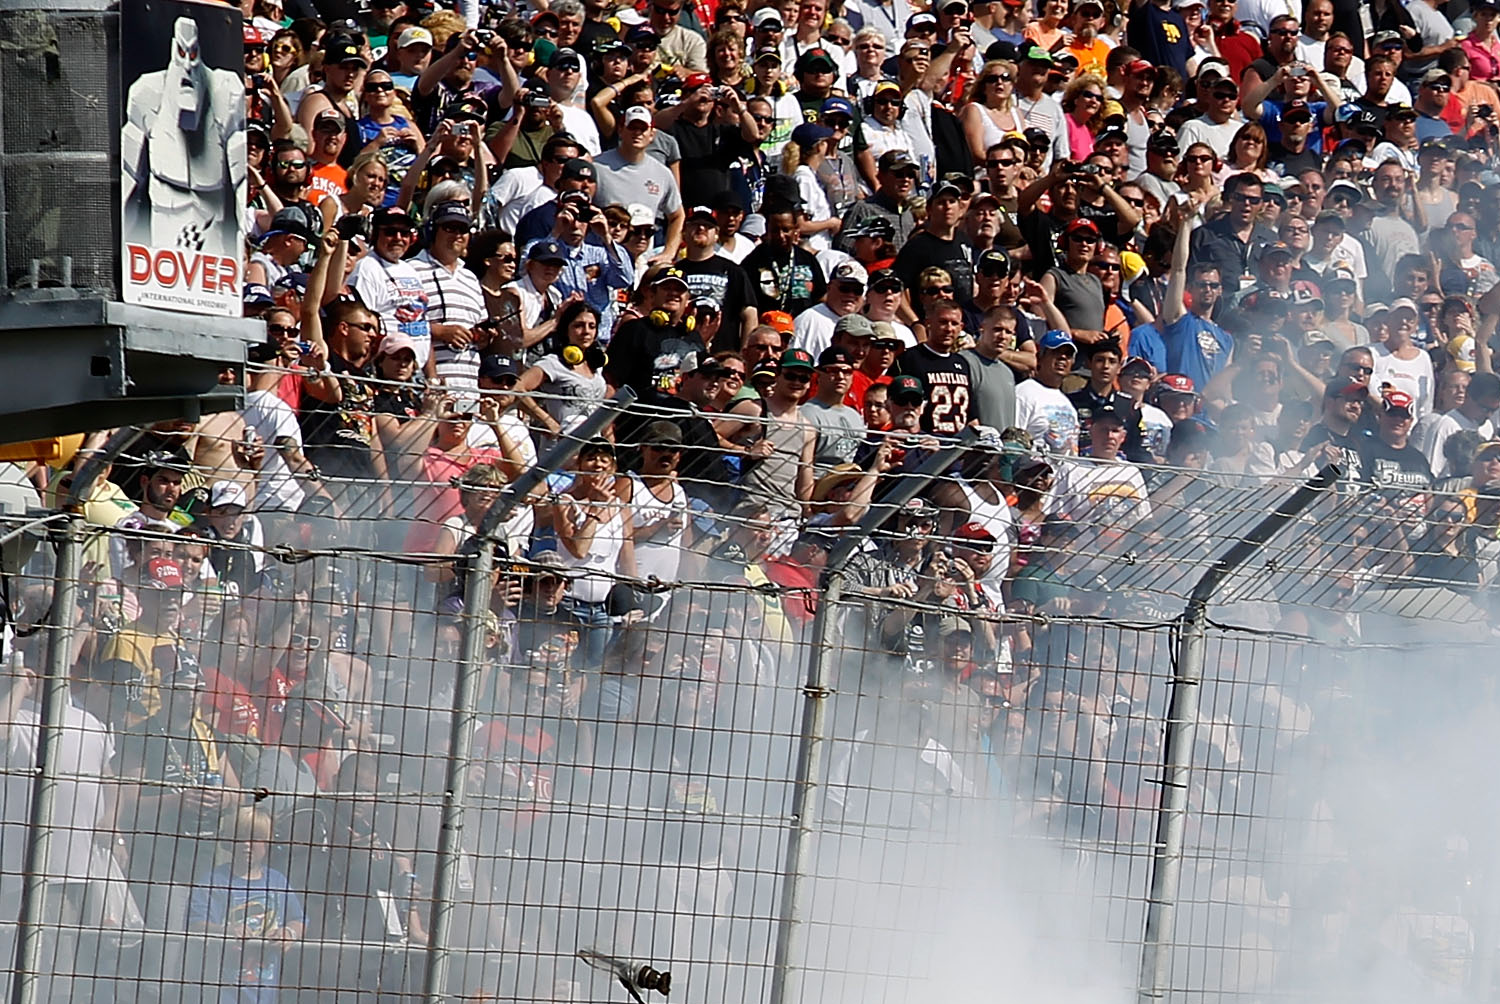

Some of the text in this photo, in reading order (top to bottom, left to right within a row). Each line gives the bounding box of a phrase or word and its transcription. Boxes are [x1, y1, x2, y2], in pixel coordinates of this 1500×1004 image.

[127, 243, 239, 298] DOVER
[141, 292, 194, 306] INTERNATIONAL
[927, 371, 970, 387] MARYLAND
[930, 384, 970, 434] 23
